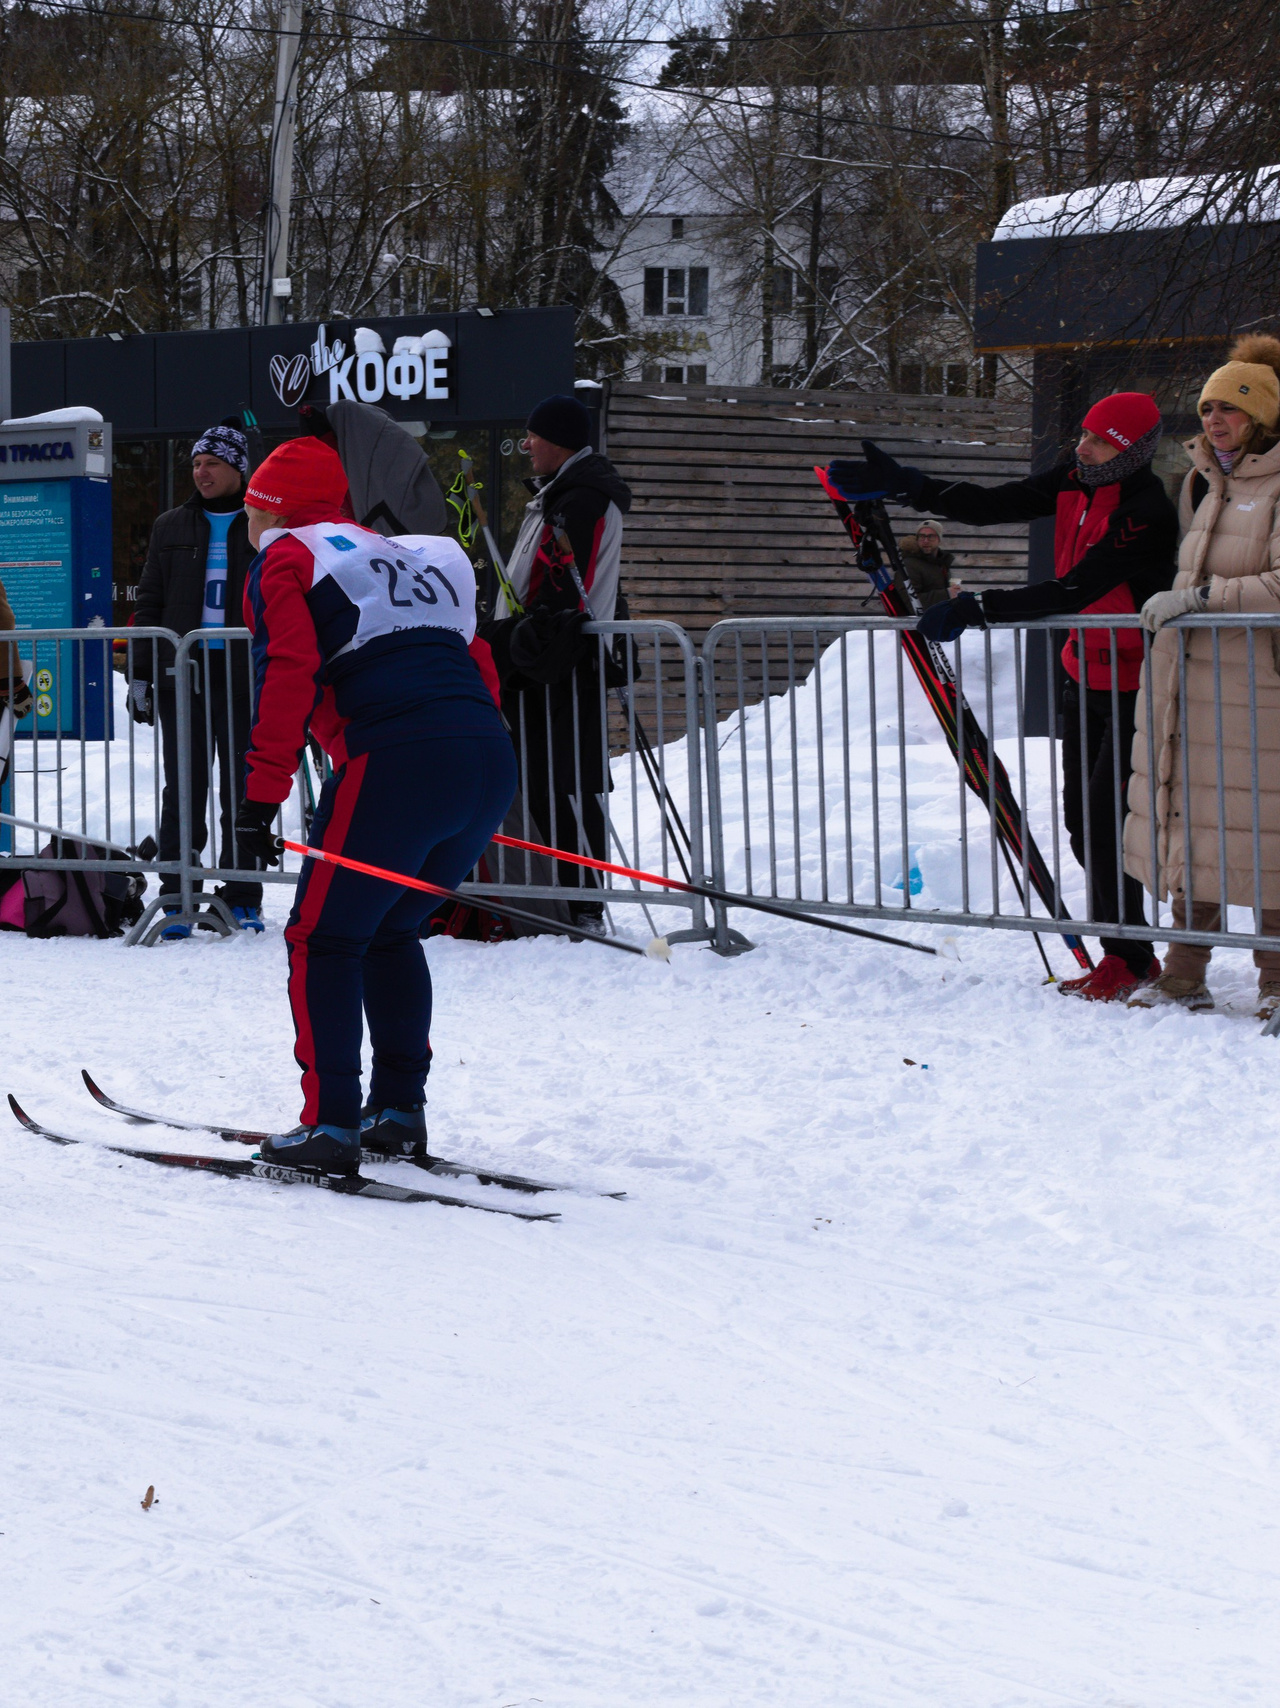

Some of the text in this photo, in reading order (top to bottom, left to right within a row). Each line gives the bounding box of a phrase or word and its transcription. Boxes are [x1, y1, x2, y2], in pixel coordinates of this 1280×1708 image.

[310, 324, 346, 376] the
[329, 347, 450, 404] КОФЕ
[1106, 428, 1133, 446] MAD
[8, 441, 75, 463] ТРАССА
[4, 493, 38, 504] Внимание!
[247, 487, 283, 504] MADSHUS
[12, 508, 53, 518] БЕЗОПАСНОСТИ
[370, 557, 460, 608] 231
